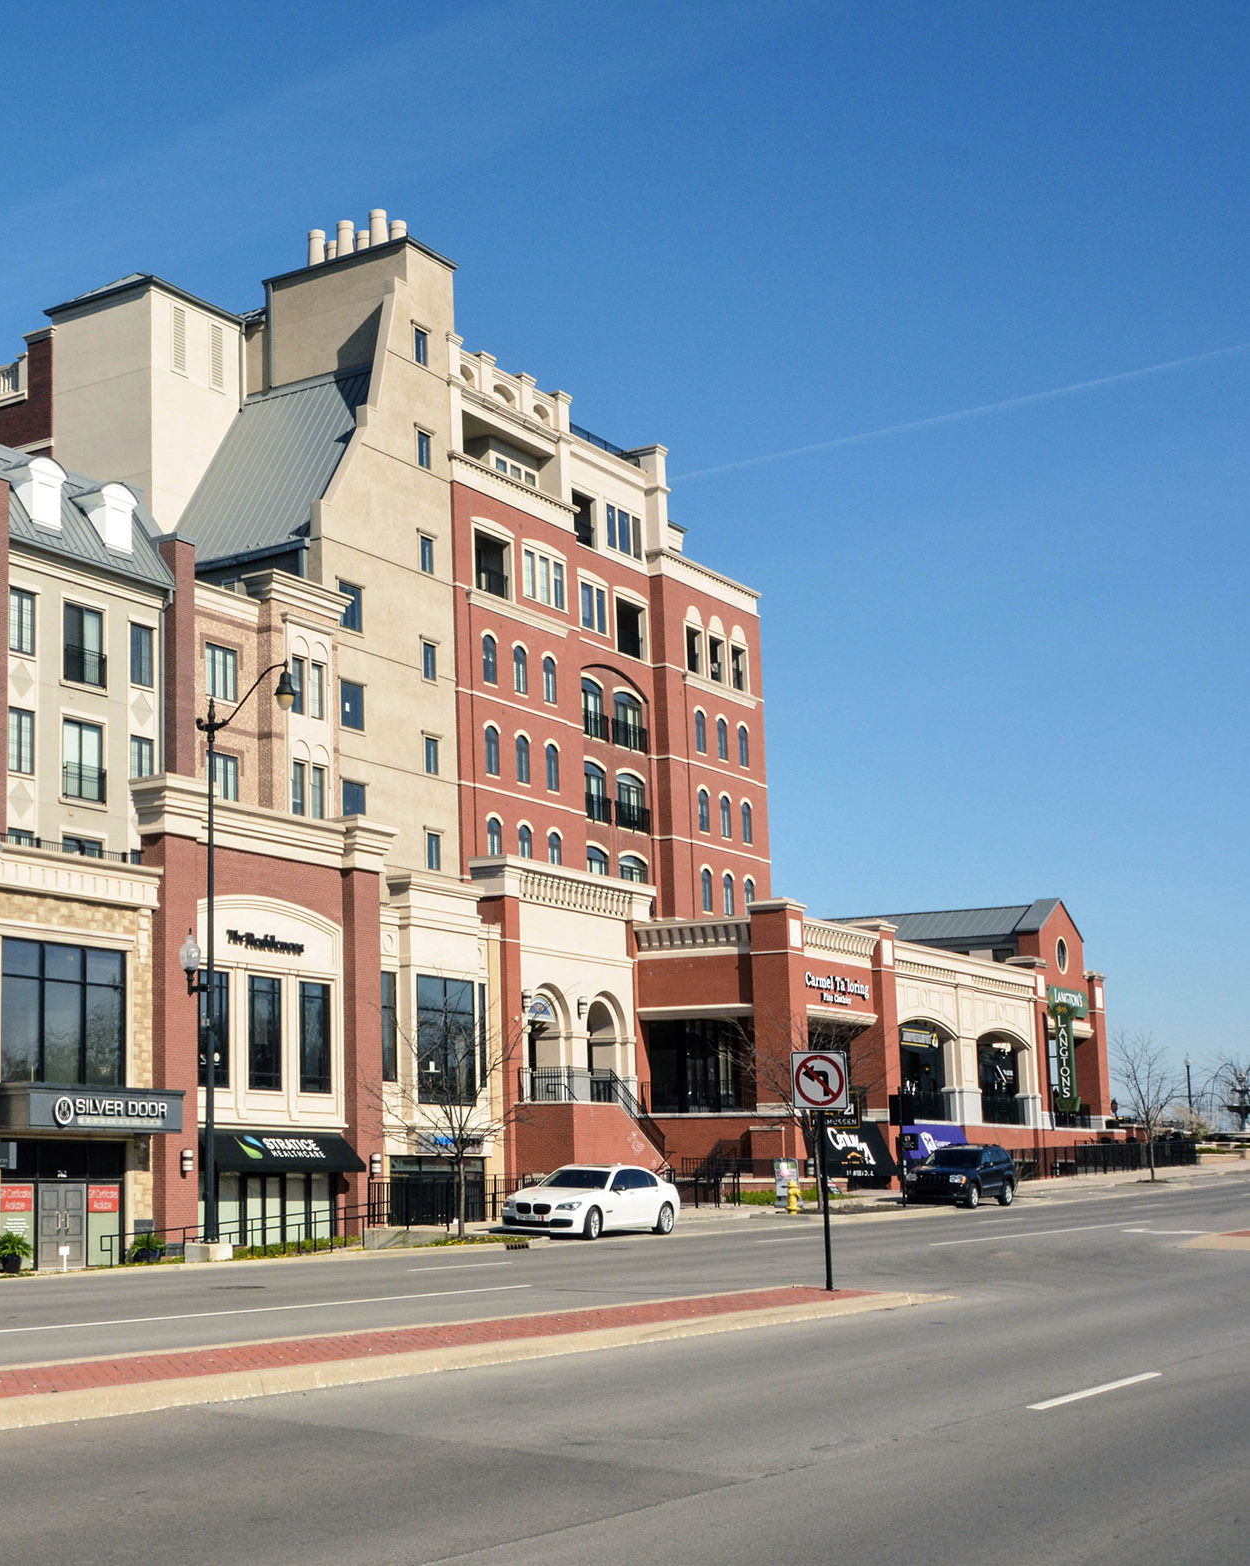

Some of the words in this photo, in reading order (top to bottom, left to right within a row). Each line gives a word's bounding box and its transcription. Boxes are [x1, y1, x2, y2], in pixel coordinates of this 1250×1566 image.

[226, 929, 244, 945] The
[245, 932, 304, 956] Residences
[805, 971, 834, 990] Carmel
[1057, 1015, 1070, 1098] LANGTONS
[76, 1098, 124, 1115] SILVER
[128, 1101, 167, 1118] DOOR
[262, 1137, 321, 1151] STRATICE
[270, 1150, 327, 1159] HEALTHCARE
